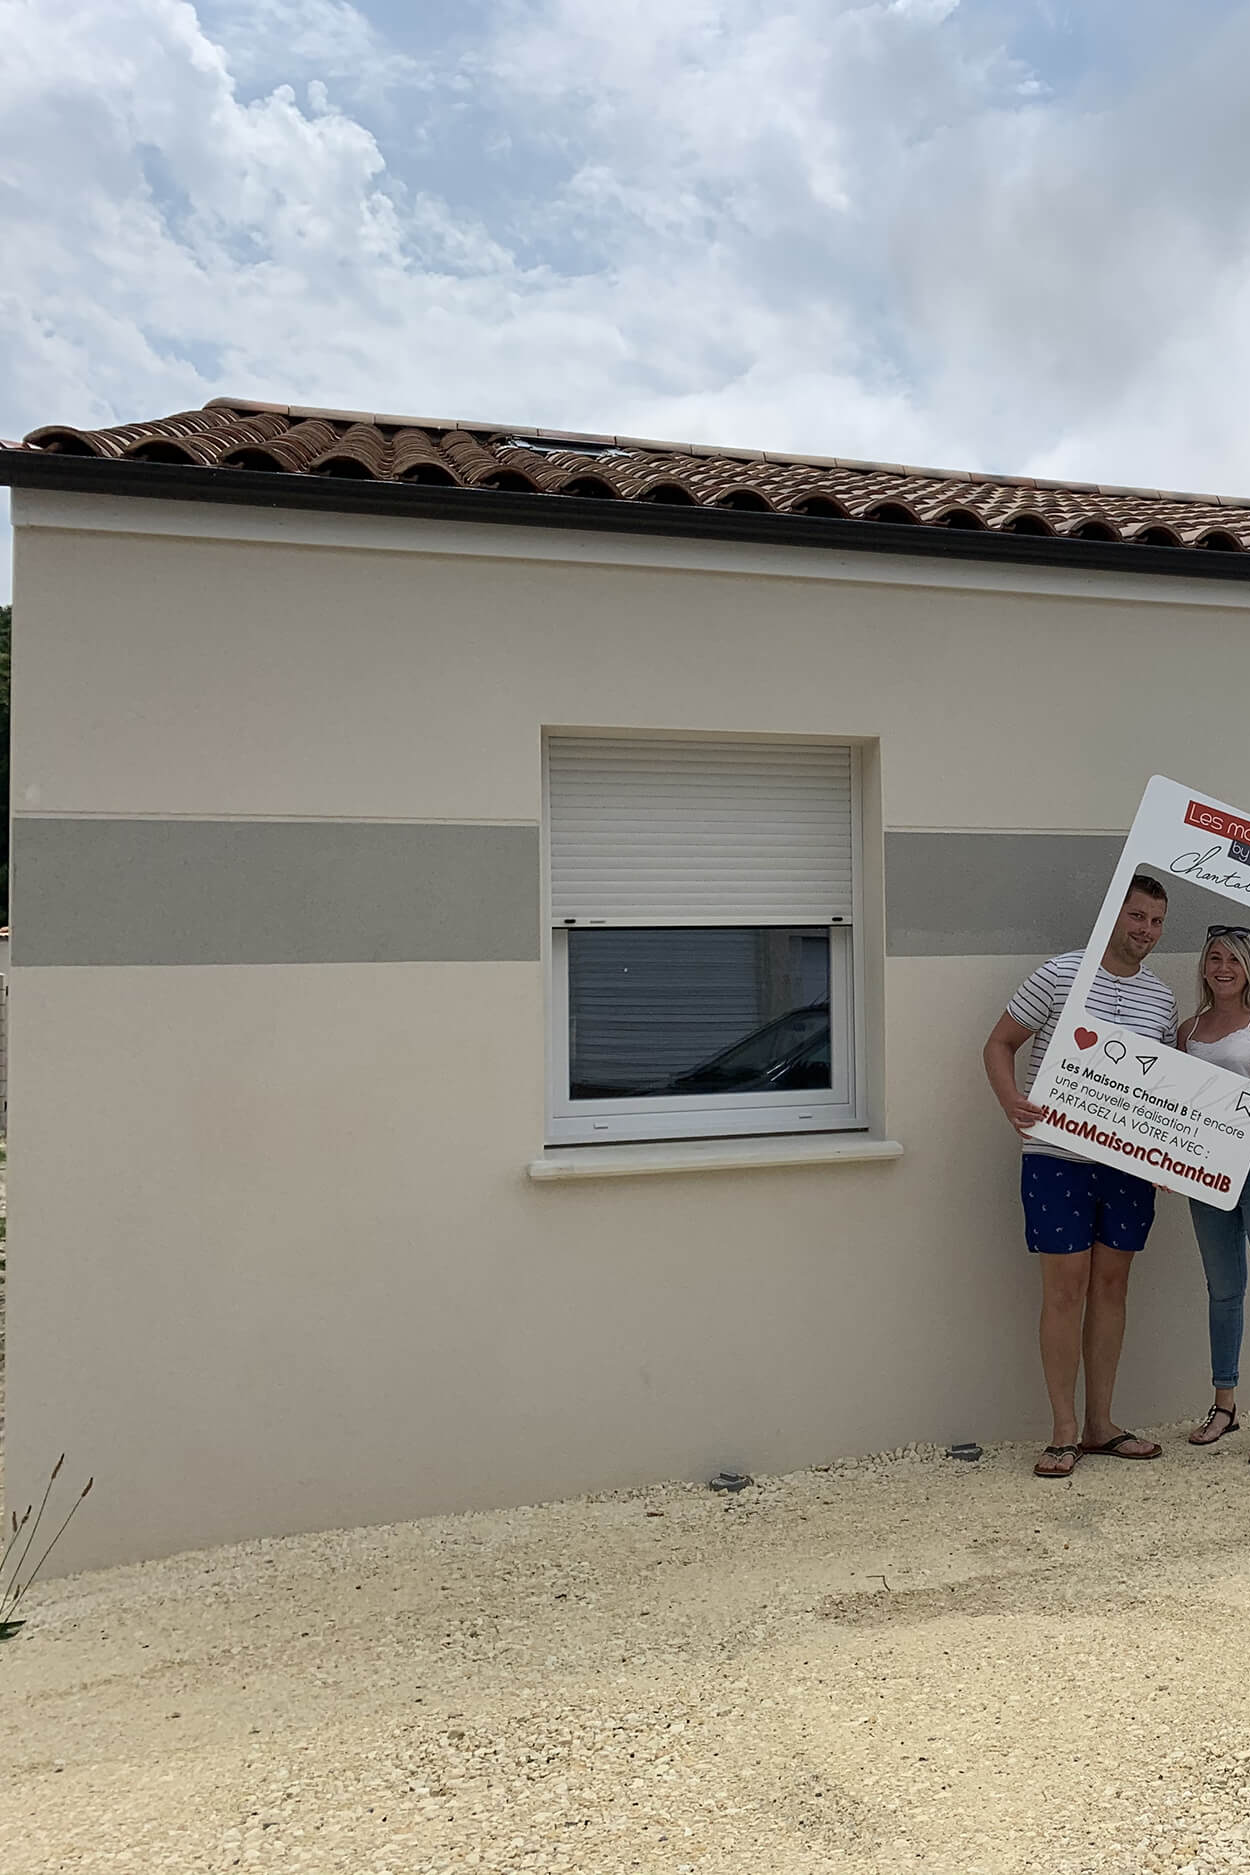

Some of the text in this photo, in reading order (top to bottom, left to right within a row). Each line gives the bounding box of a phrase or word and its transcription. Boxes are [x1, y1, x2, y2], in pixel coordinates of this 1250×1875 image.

[1189, 804, 1223, 830] Les
[1232, 840, 1250, 861] by
[1049, 1088, 1111, 1119] PARTAGEZ
[1112, 1111, 1127, 1126] LA
[1132, 1117, 1168, 1144] VÔTRE
[1170, 1136, 1204, 1157] AVEC
[1055, 1076, 1198, 1138] une nouvelle réalisation !
[1061, 1059, 1245, 1139] Les Maisons Chantal B Et encore
[1040, 1105, 1231, 1193] #MaMaisonChantalB
